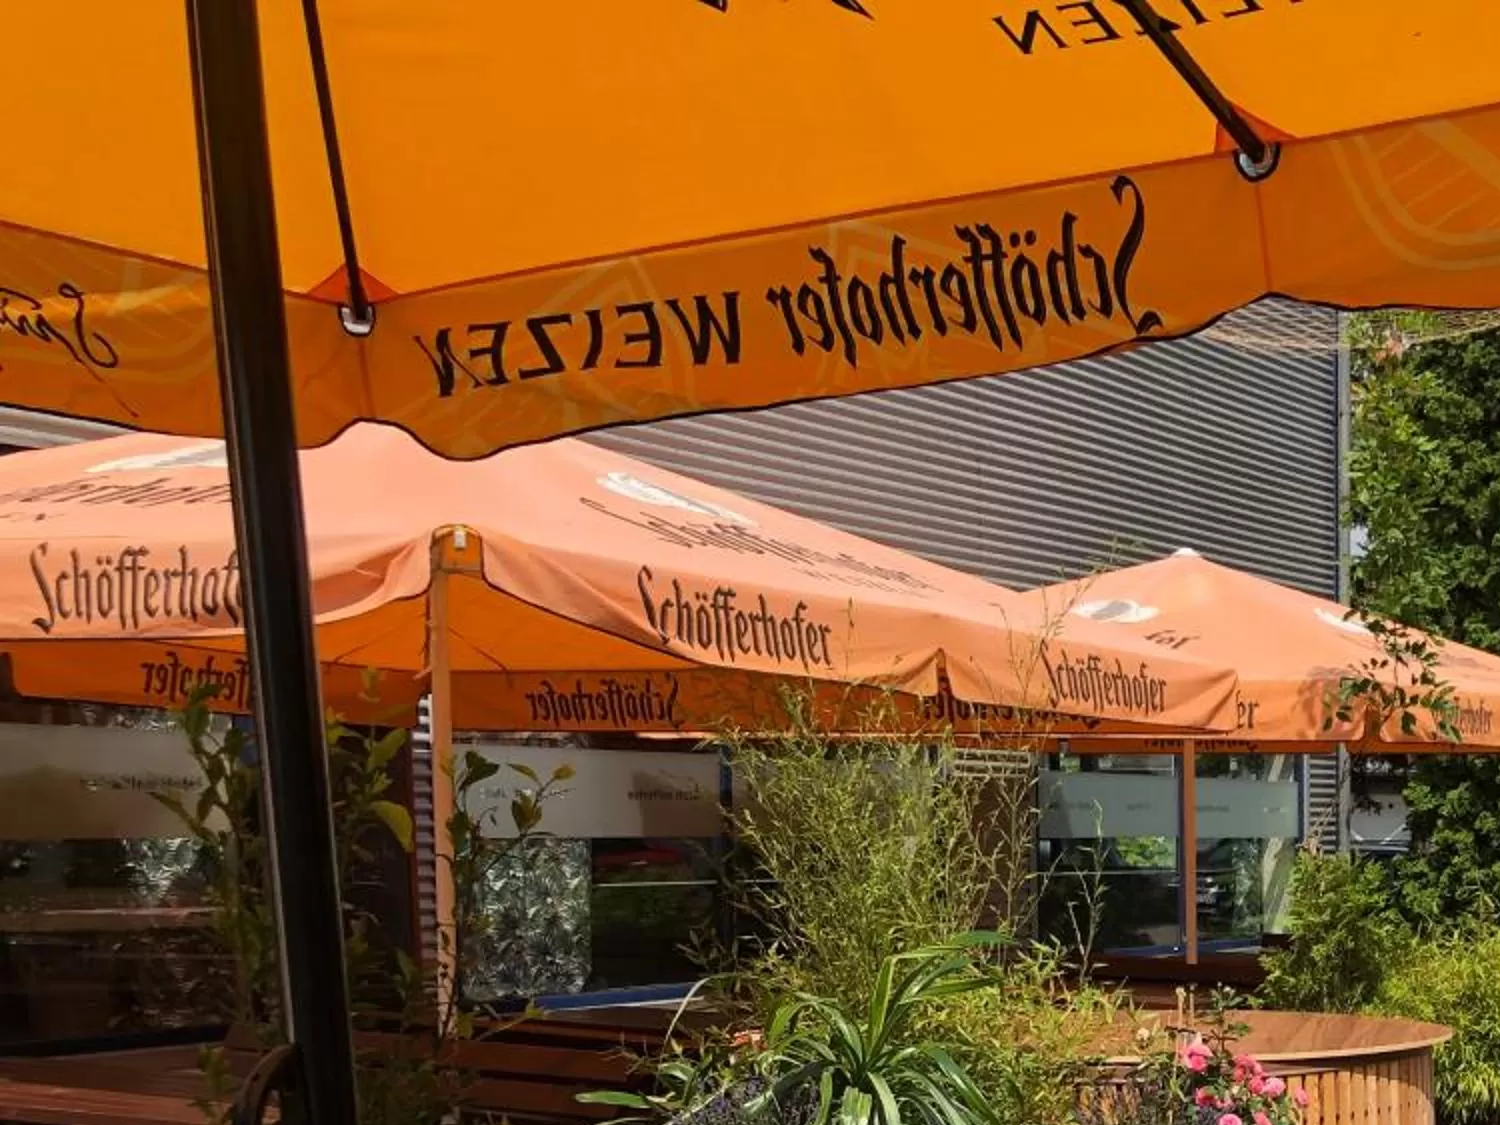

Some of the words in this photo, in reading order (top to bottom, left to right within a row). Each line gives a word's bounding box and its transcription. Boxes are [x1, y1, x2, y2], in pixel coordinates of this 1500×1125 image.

[29, 541, 242, 635] Schöfferhof
[636, 564, 833, 673] Schöfferhofer
[1040, 637, 1167, 718] Schöfferhofer
